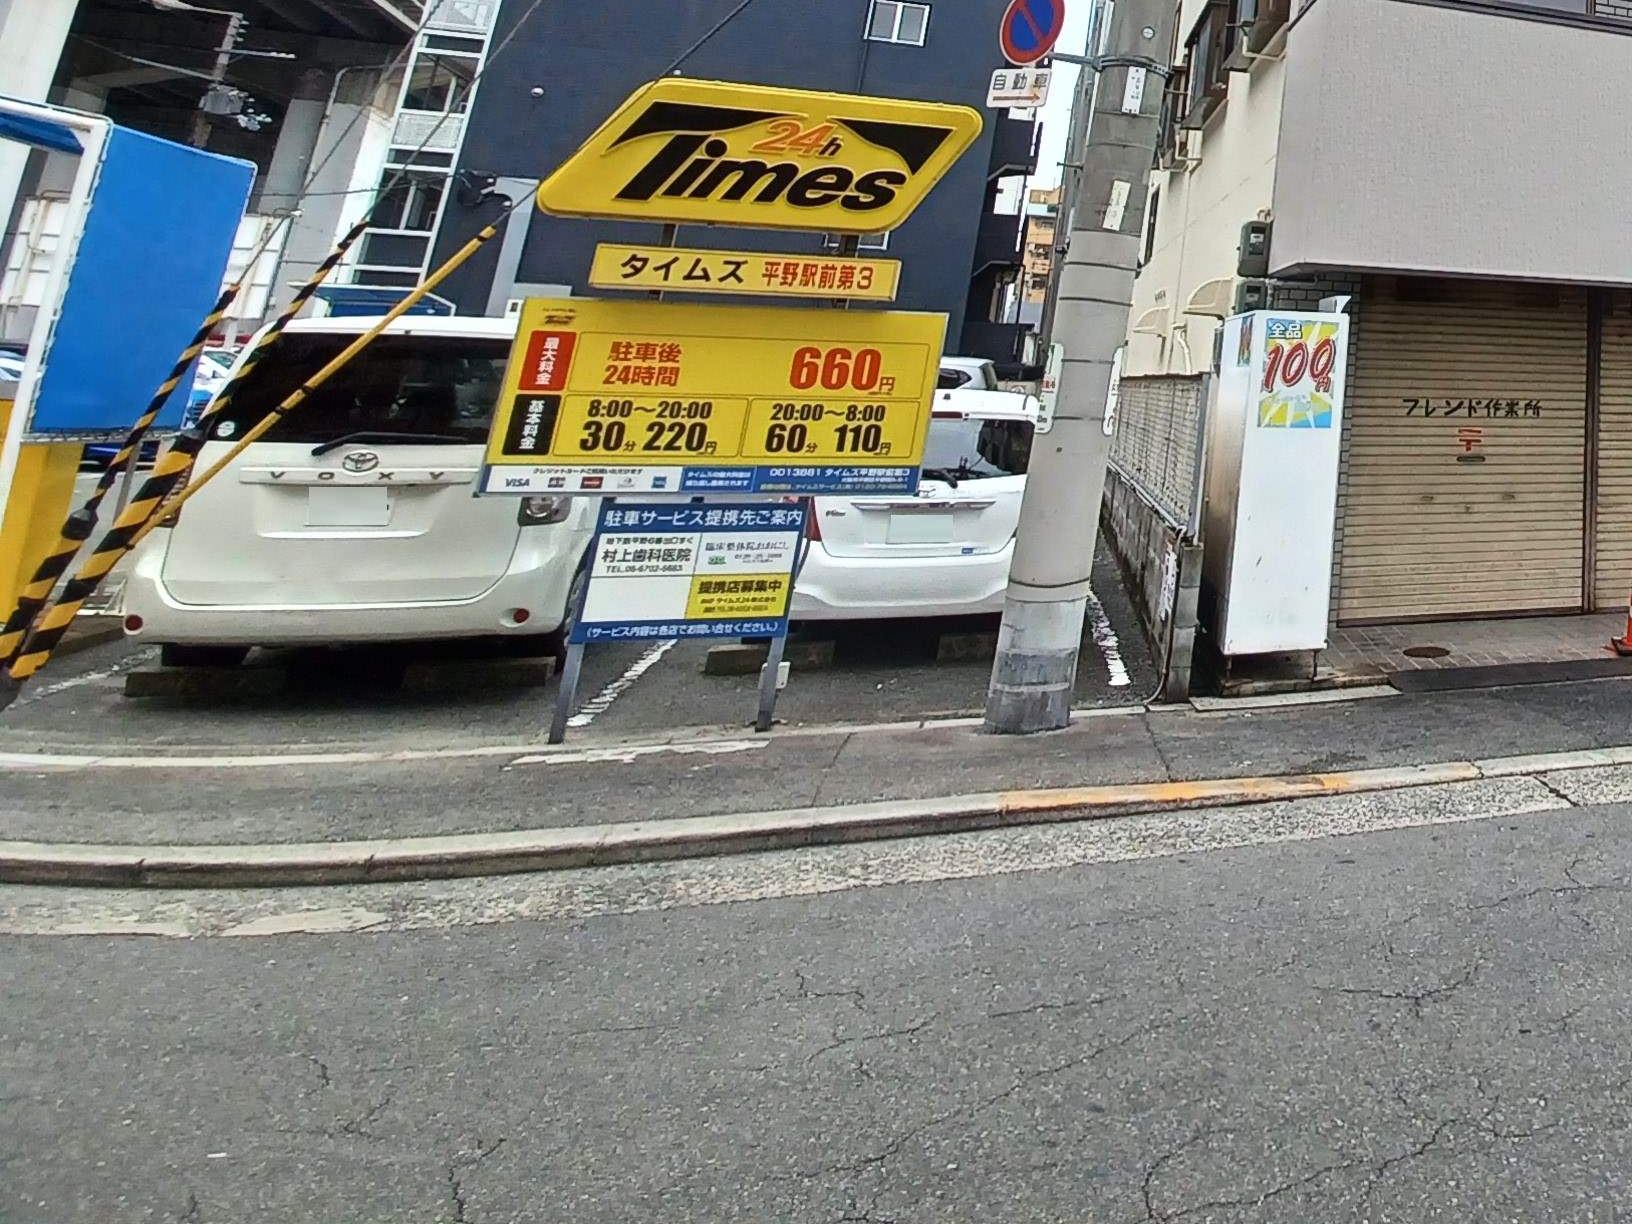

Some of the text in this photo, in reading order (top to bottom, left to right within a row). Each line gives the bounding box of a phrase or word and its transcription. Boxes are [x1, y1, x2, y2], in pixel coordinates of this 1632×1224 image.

[993, 73, 1048, 90] 自動車
[752, 119, 842, 156] 24h
[613, 133, 907, 210] Times
[621, 253, 874, 290] タイムズ 平野駅前第3
[1268, 322, 1303, 339] 全品
[535, 337, 560, 384] 最大料金
[608, 341, 682, 363] 駐車後
[603, 365, 681, 387] 24時間
[1402, 398, 1543, 417] フレンド作業所
[519, 400, 545, 449] 基本料金
[270, 471, 444, 481] VOXY
[505, 477, 530, 487] VISA
[604, 509, 803, 527] 駐車サービス提携先ご案内
[601, 548, 692, 563] 村上歯科医院
